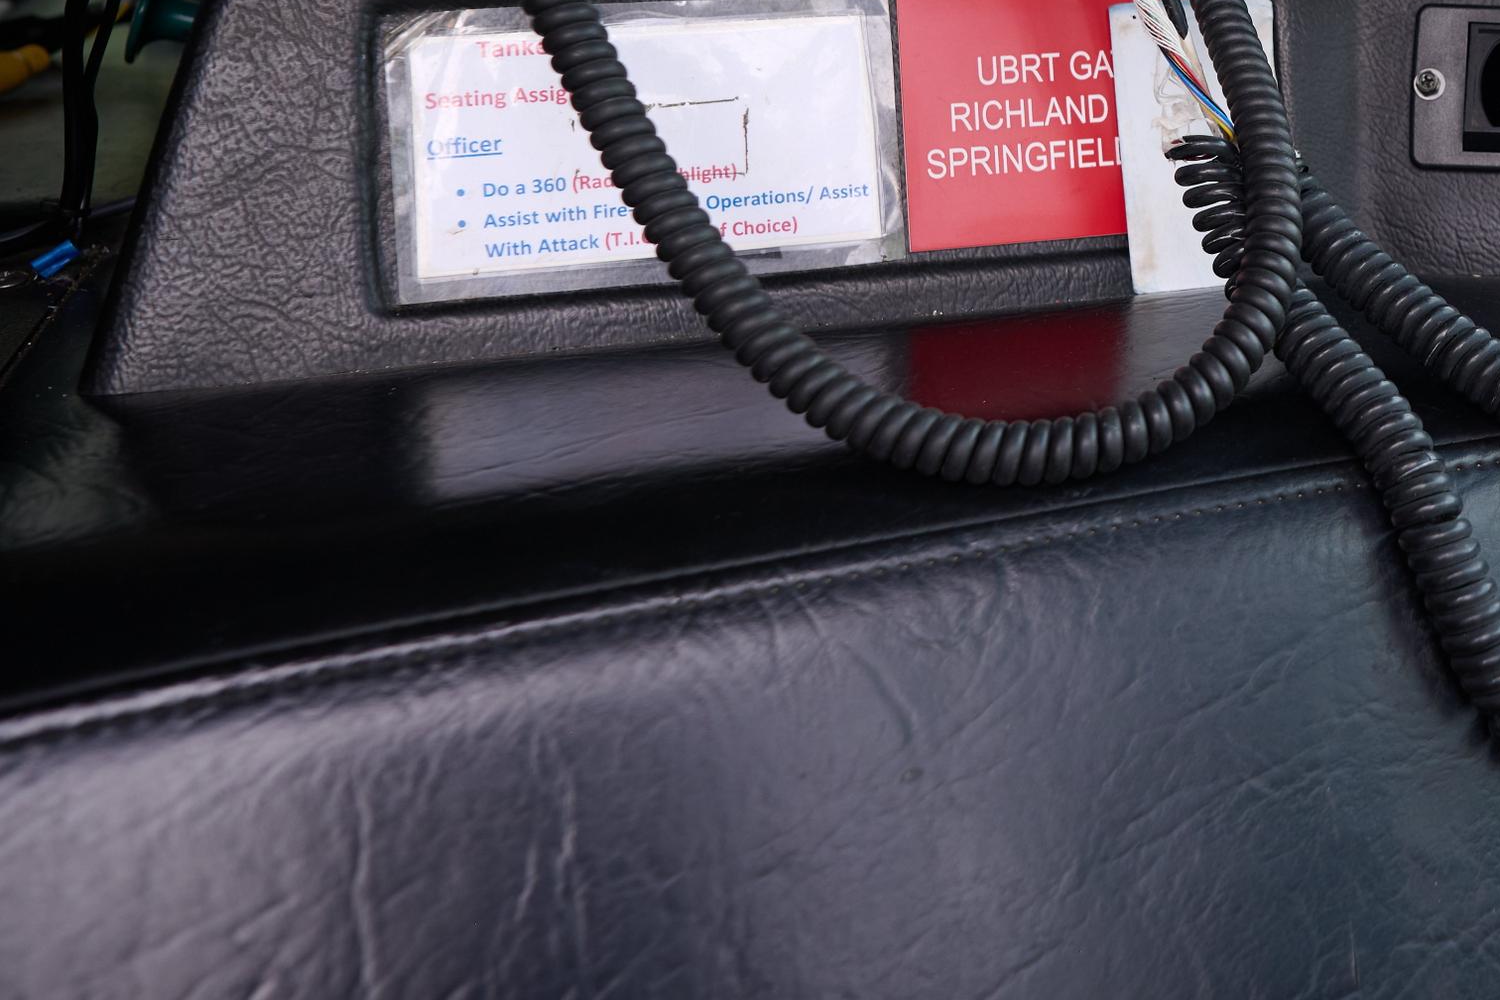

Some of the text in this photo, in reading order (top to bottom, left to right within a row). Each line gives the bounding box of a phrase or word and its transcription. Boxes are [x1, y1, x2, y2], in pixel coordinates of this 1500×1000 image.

[476, 40, 546, 58] Tanke
[976, 49, 1115, 87] UBRT GA
[425, 85, 571, 109] Seating Assig
[950, 93, 1109, 133] RICHLAND
[427, 136, 503, 158] Officer
[482, 162, 737, 198] Do a 360 (Rad hlight)
[484, 210, 539, 229] Assist
[545, 205, 587, 223] with
[594, 203, 634, 219] Fire-
[819, 183, 870, 201] Assist
[485, 241, 532, 259] With
[537, 233, 600, 254] Attack
[732, 215, 798, 238] Choice)
